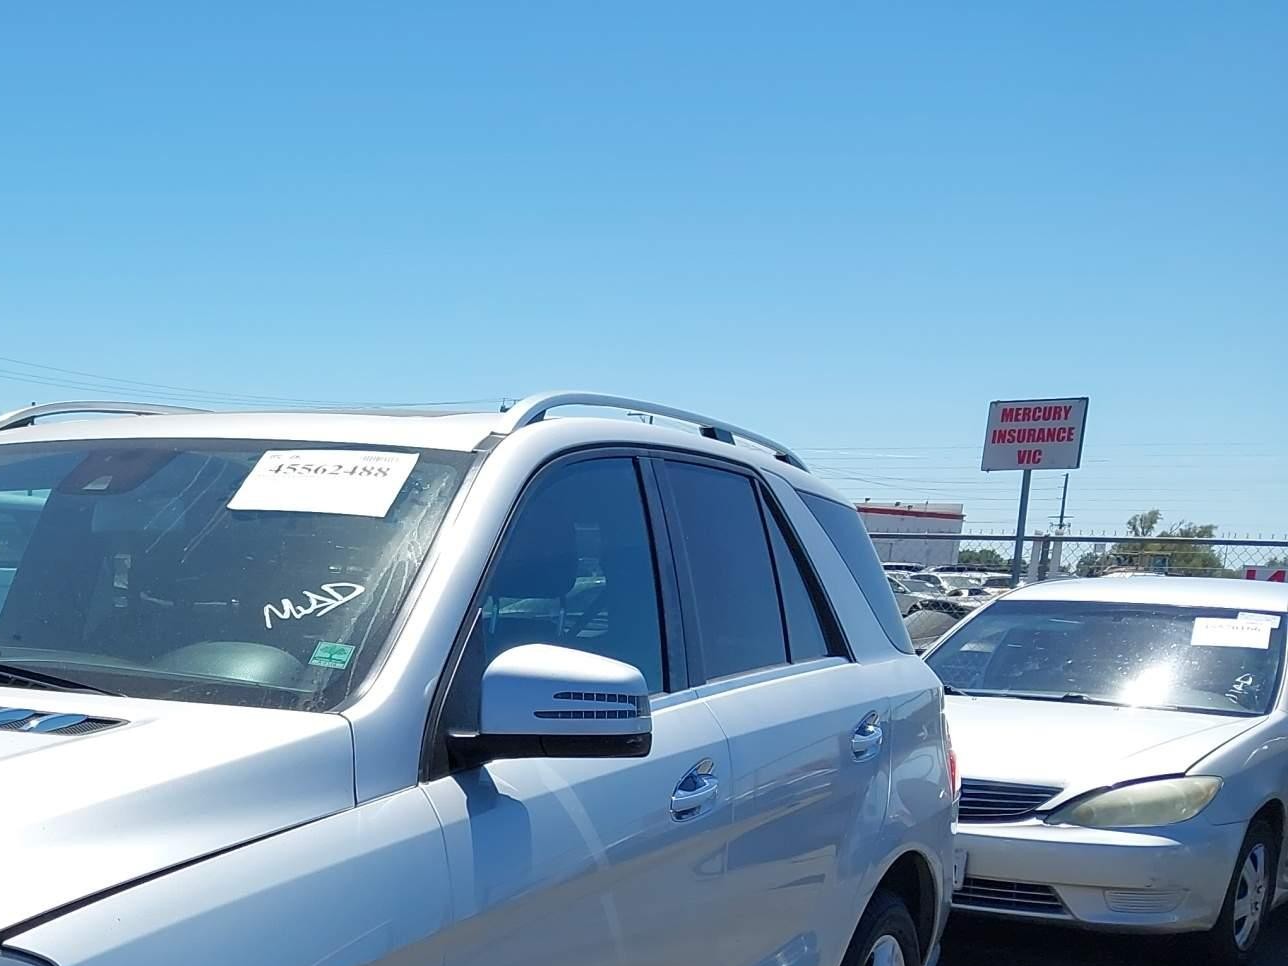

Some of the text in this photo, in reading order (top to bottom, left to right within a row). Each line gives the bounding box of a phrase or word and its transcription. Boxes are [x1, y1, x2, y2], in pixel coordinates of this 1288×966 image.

[1001, 406, 1072, 423] MERCURY
[991, 427, 1075, 444] INSURANCE
[1017, 449, 1042, 465] VIC
[269, 463, 390, 477] 45562488
